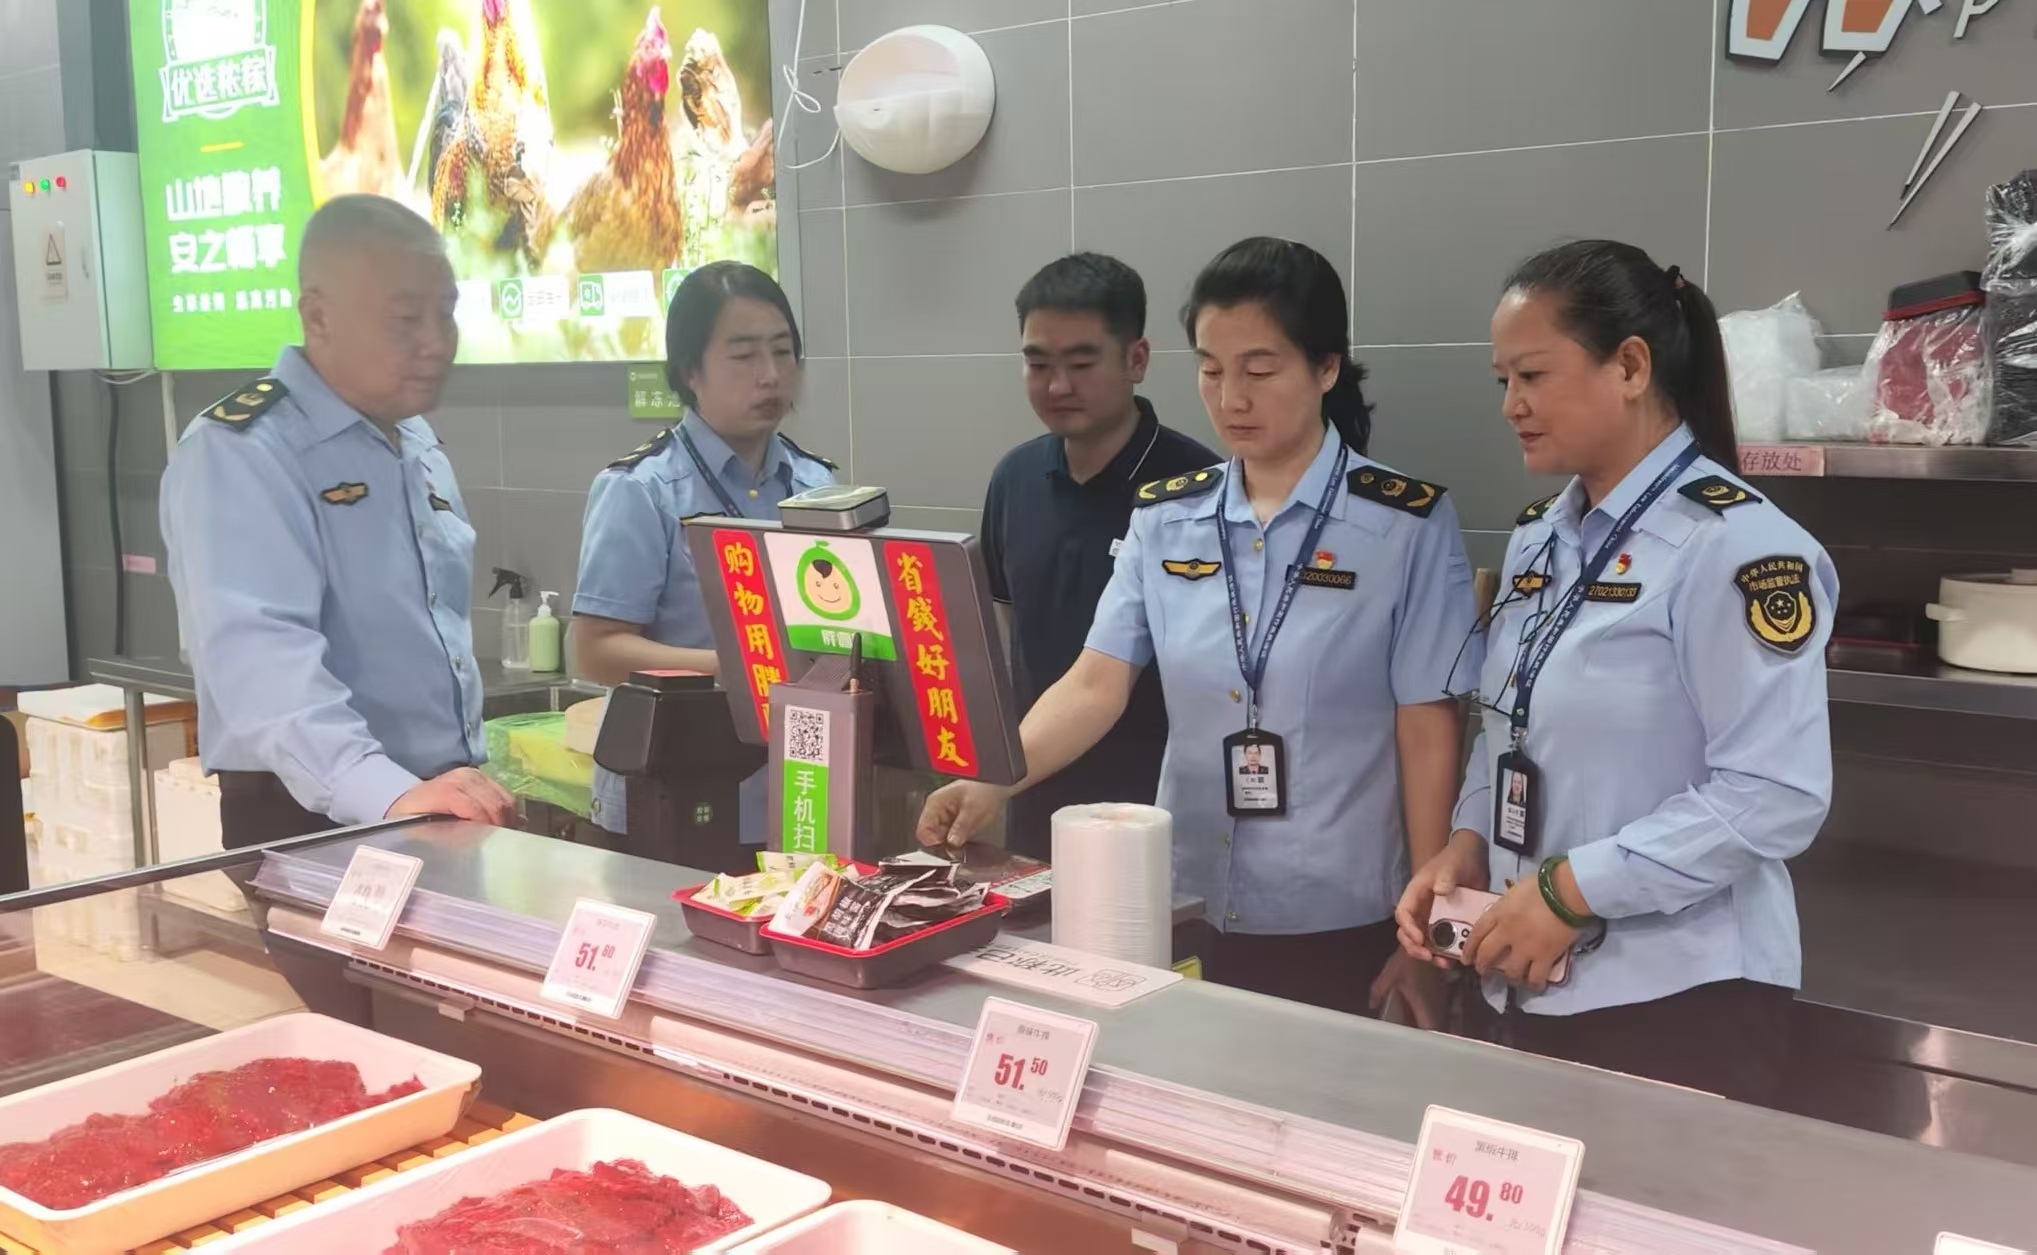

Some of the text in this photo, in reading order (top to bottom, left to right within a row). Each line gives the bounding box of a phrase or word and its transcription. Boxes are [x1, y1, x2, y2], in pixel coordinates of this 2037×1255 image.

[1743, 451, 1802, 471] 存放处
[1741, 560, 1804, 583] 中华人民共和国
[724, 541, 783, 729] 购物用胖
[793, 769, 816, 853] 手机扫
